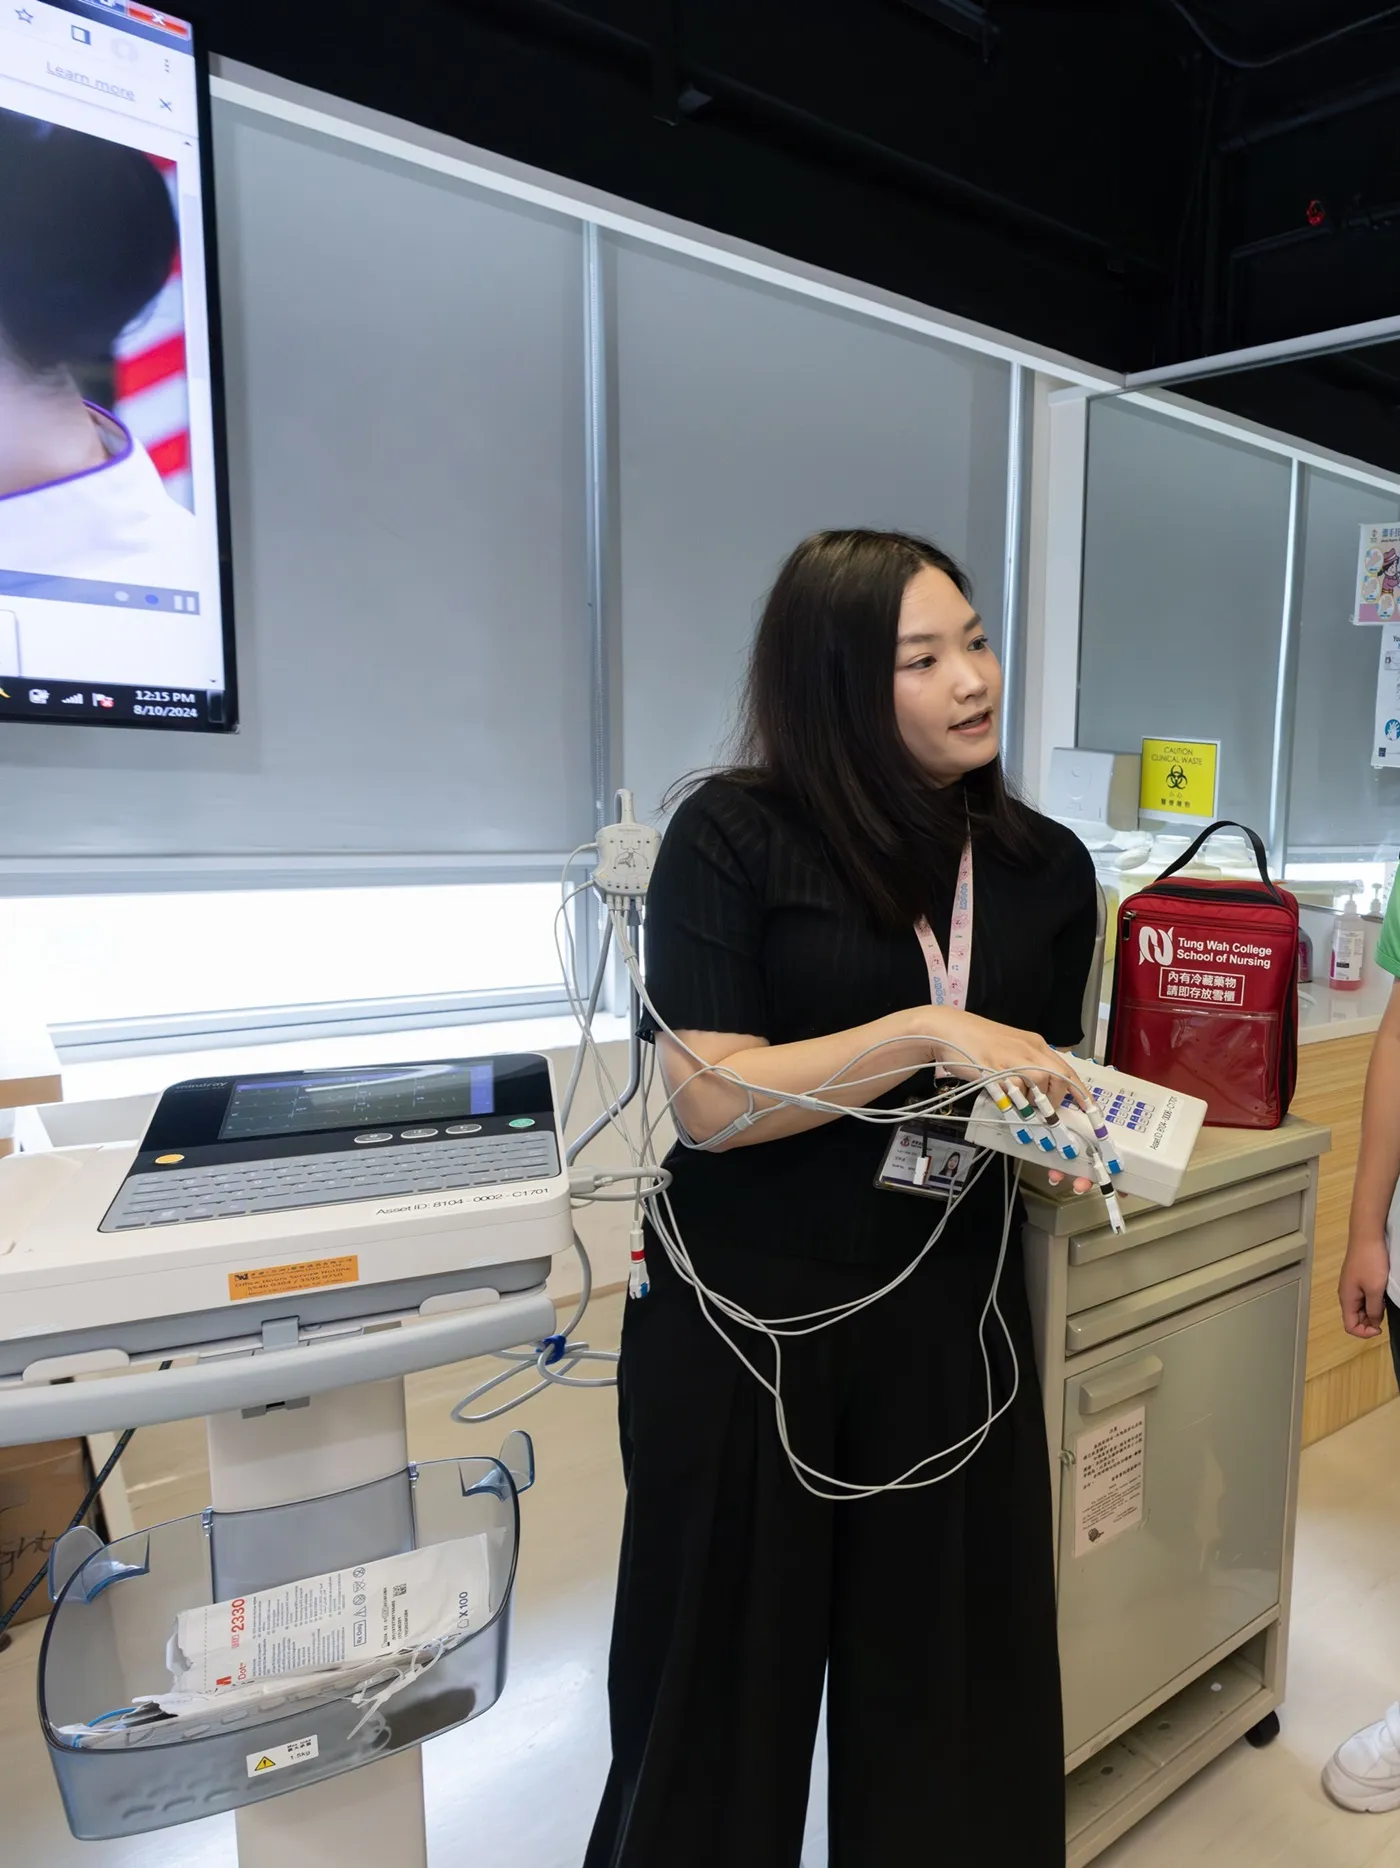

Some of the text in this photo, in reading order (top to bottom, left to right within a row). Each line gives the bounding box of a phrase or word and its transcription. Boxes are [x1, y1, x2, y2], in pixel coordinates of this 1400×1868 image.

[46, 61, 135, 100] Learn more
[135, 690, 196, 703] 12:15 PM
[133, 705, 198, 718] 8/10/2024
[1151, 754, 1202, 765] CLINICAL WASTE
[1163, 746, 1193, 756] CAUTION
[1178, 937, 1272, 957] Tung Wah College
[1176, 949, 1271, 969] School of Nursing
[1166, 984, 1236, 1002] 請即存放雪櫃
[376, 1205, 412, 1215] Asset
[414, 1203, 430, 1211] ID:
[433, 1199, 464, 1208] 8104
[473, 1194, 503, 1203] 0002
[512, 1188, 549, 1198] C1701
[459, 1591, 468, 1618] X 100
[231, 1598, 245, 1633] 2330
[356, 1623, 364, 1636] Only
